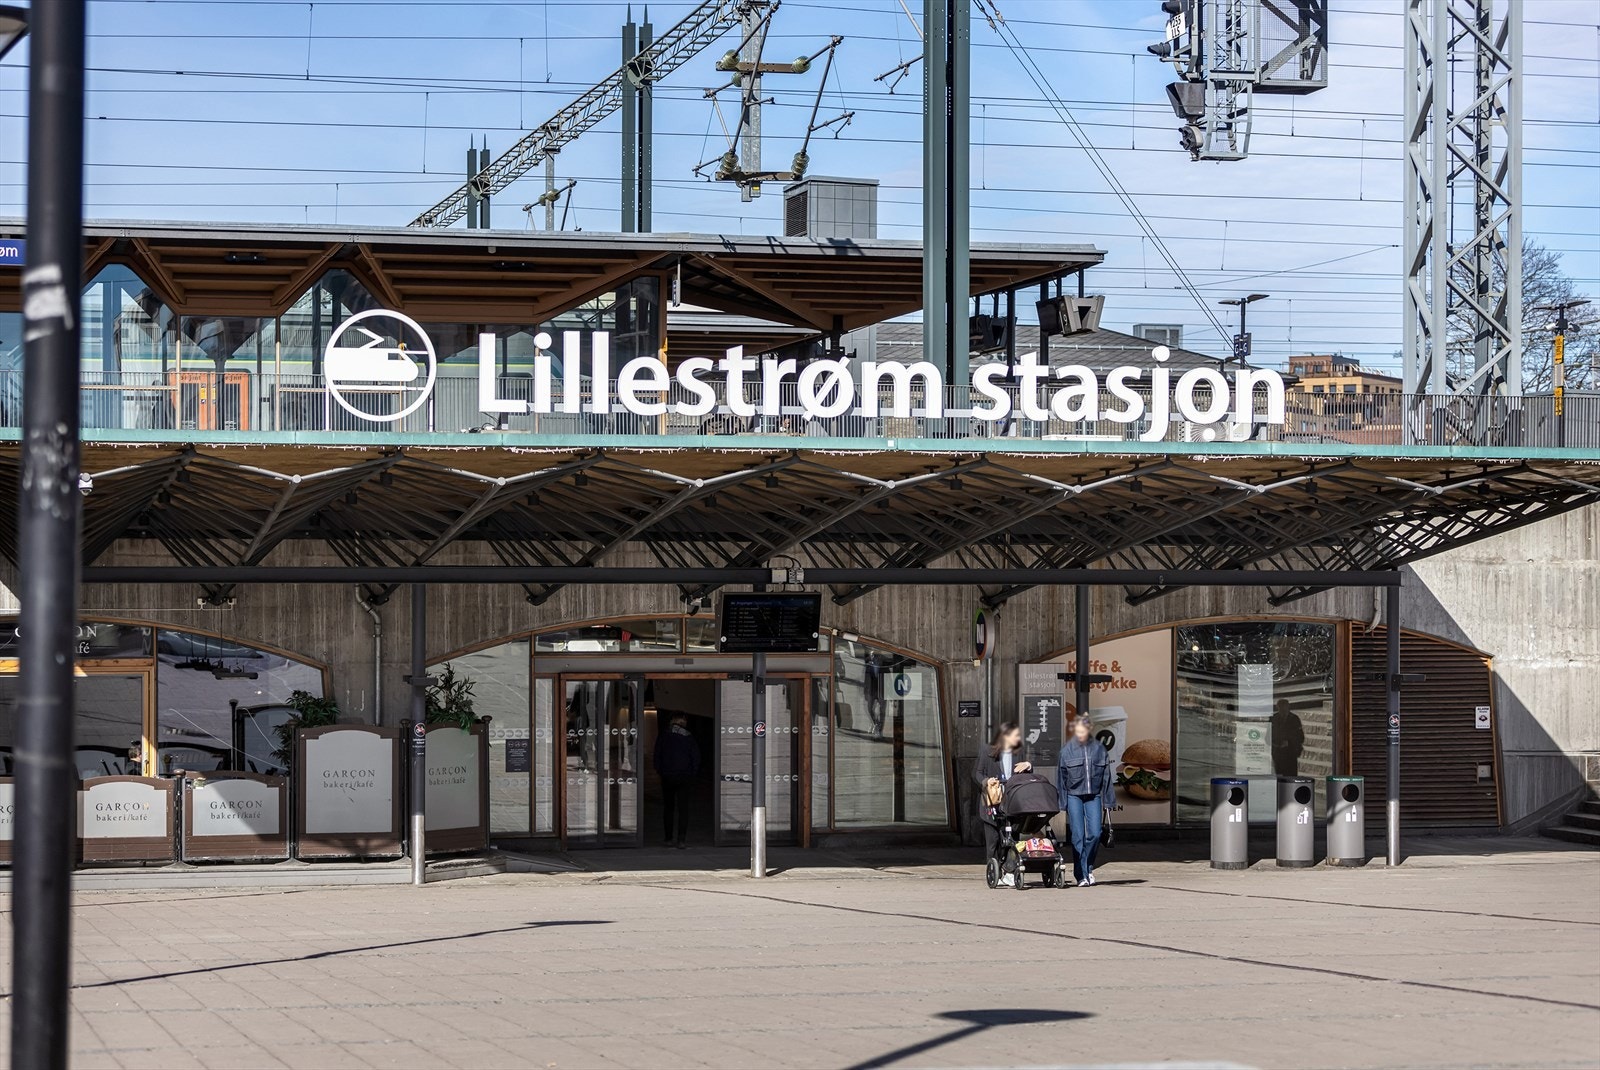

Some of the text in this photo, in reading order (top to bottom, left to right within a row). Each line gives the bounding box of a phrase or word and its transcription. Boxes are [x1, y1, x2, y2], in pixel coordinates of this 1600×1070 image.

[479, 331, 1285, 442] Lillestrøm stasjon
[1068, 660, 1122, 673] Kffe &
[897, 679, 908, 691] N
[322, 769, 376, 779] GARÇON
[428, 766, 467, 777] GARÇON
[323, 780, 374, 788] bakeri/kafé
[210, 800, 263, 810] GARÇON
